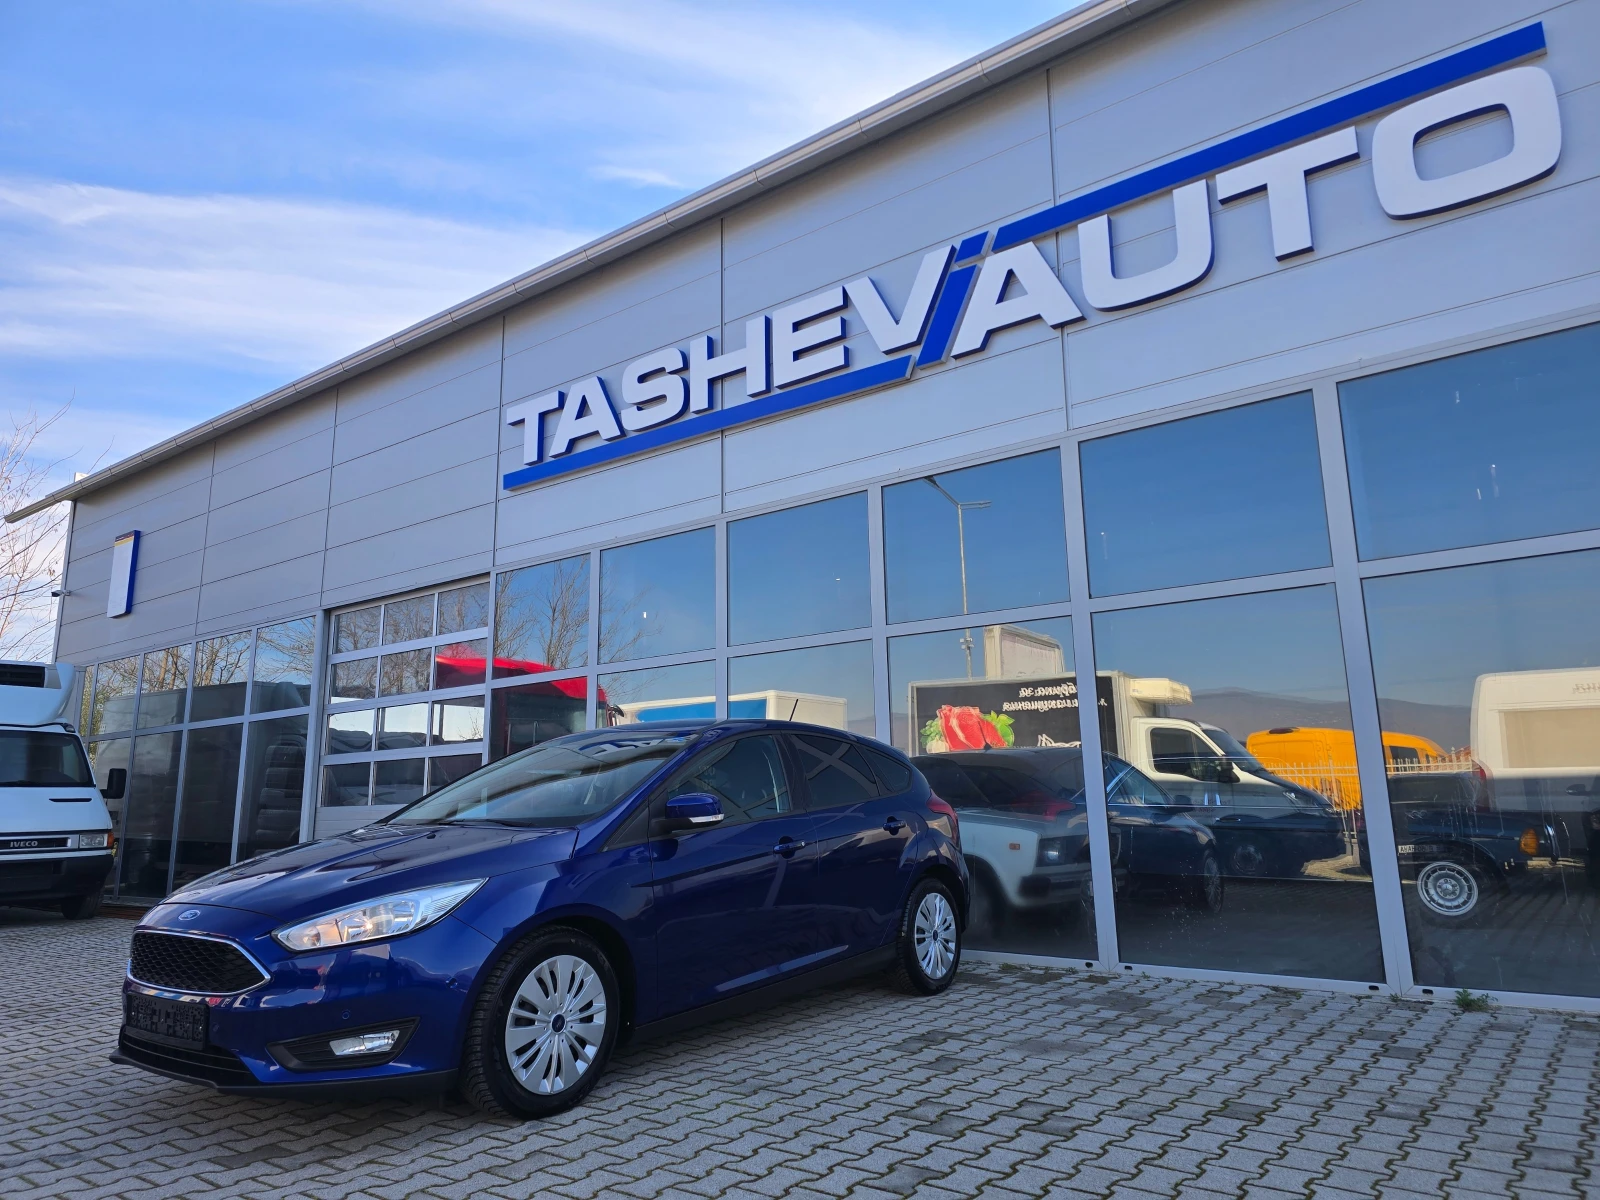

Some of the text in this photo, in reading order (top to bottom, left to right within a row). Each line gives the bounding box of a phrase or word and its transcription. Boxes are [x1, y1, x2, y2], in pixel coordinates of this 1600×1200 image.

[506, 65, 1562, 465] TASHEV AUTO
[10, 840, 39, 848] IVECO
